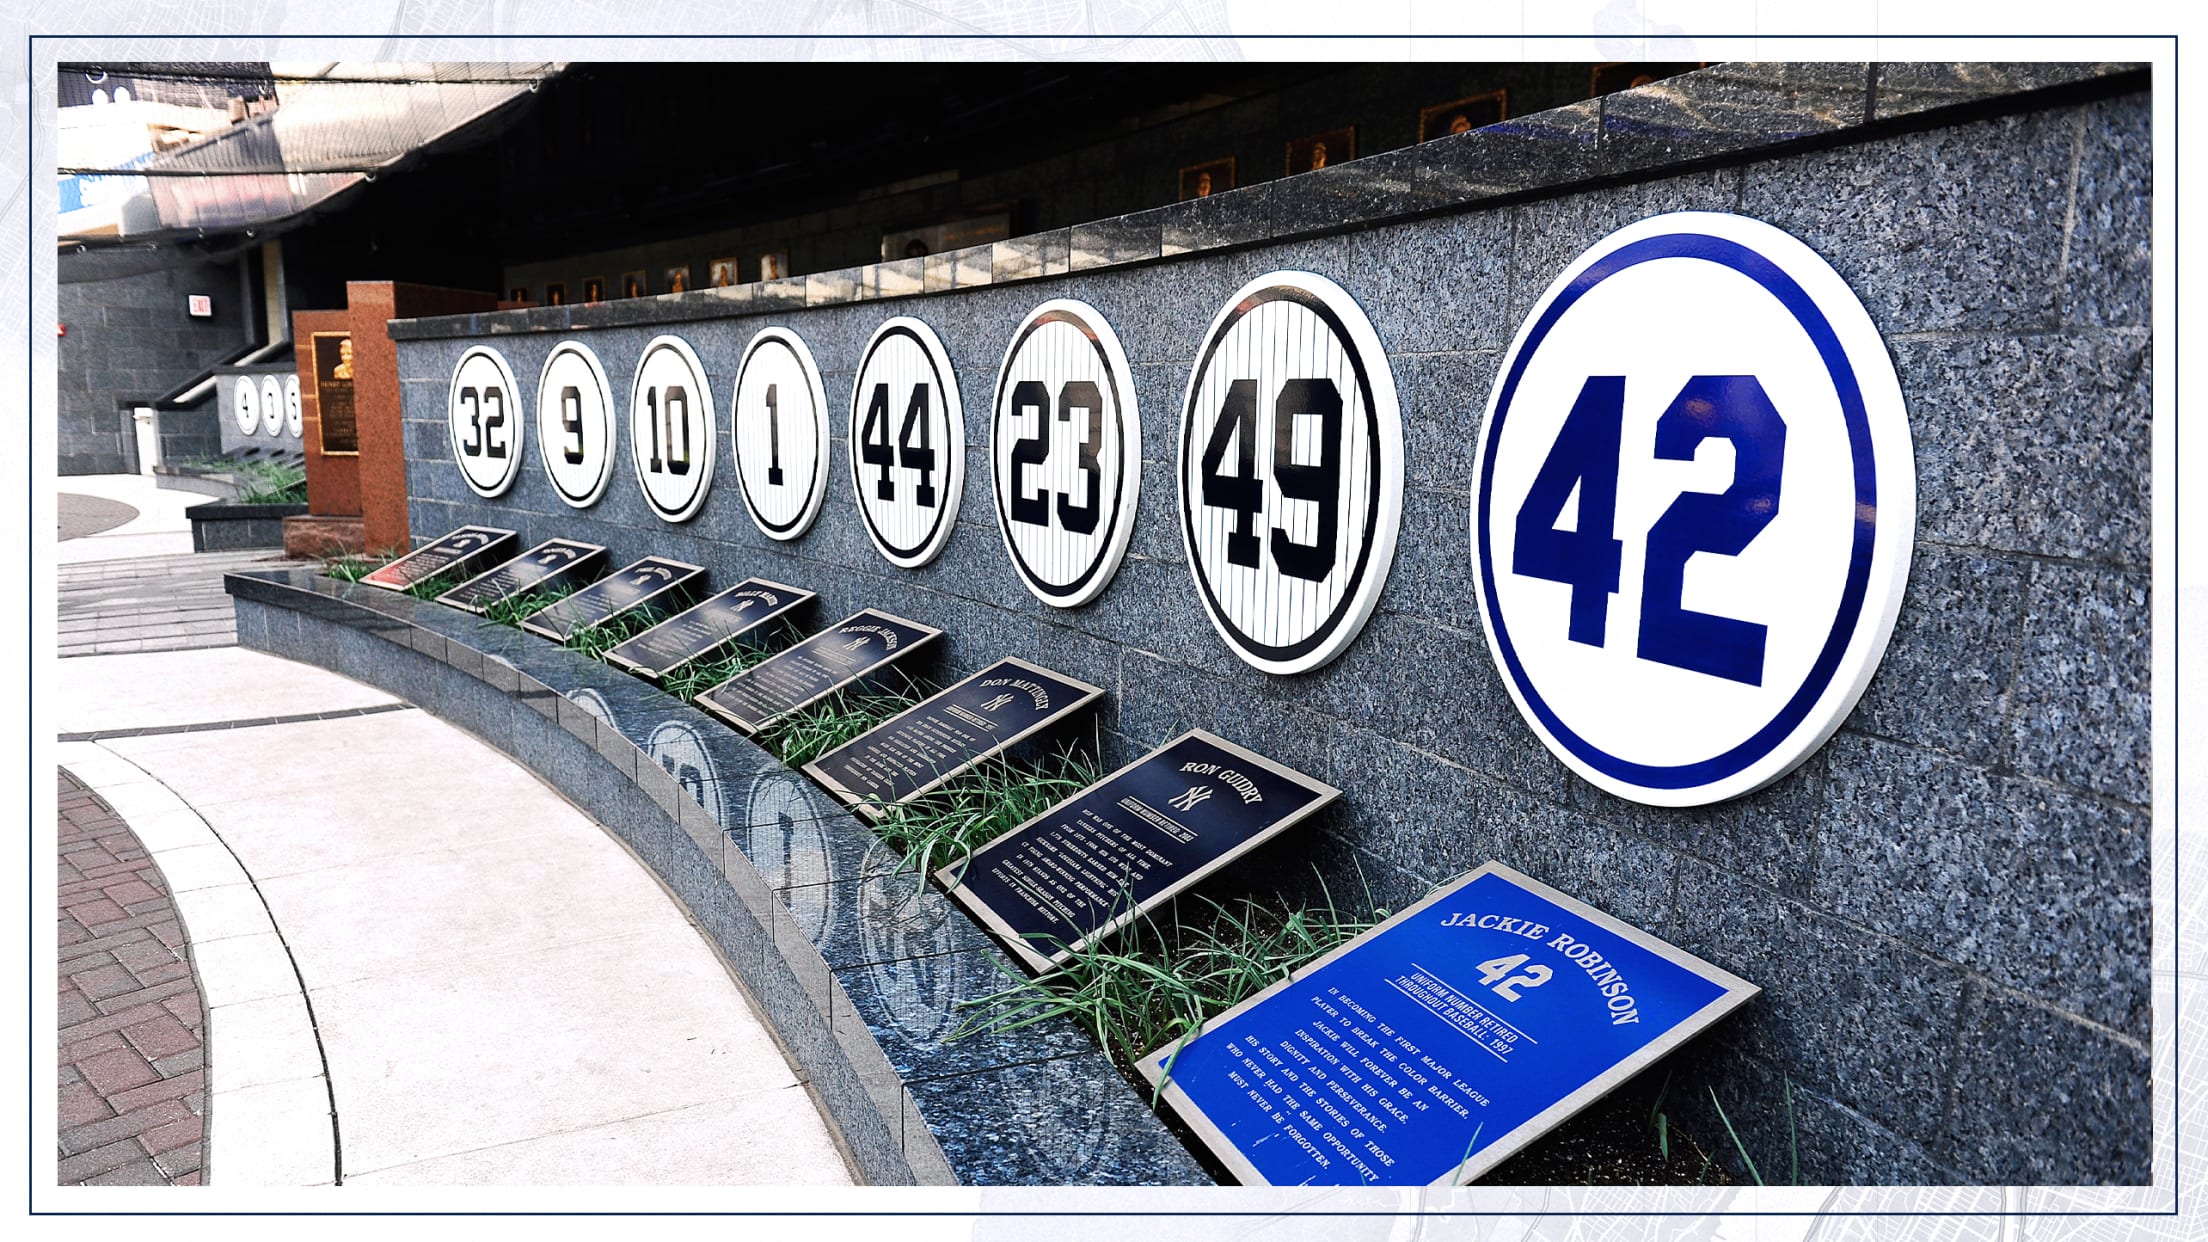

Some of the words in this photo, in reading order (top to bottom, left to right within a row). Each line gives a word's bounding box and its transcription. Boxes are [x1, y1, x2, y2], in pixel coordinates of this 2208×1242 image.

[241, 391, 250, 419] 4
[460, 386, 506, 459] 32
[562, 386, 584, 465] 9
[647, 386, 690, 476] 10
[766, 384, 783, 487] 1
[862, 383, 935, 508] 44
[1011, 381, 1102, 535] 23
[1202, 378, 1343, 583] 49
[1513, 375, 1787, 687] 42
[979, 678, 1013, 687] DON
[1009, 679, 1049, 711] MATTINGLY
[1167, 785, 1213, 812] NY
[1179, 762, 1221, 776] RON
[1218, 769, 1263, 805] GUIDRY
[1411, 973, 1449, 998] UNIFORM
[1445, 995, 1483, 1020] NUMBER
[1479, 1017, 1518, 1042] RETIRED
[1441, 913, 1549, 940] JACKIE
[1547, 933, 1640, 1026] ROBINSON
[1475, 953, 1554, 1003] 42
[1312, 997, 1338, 1017] PLAYER
[1340, 1017, 1351, 1026] TO
[1351, 1027, 1379, 1048] BREAK
[1380, 1048, 1397, 1062] THE
[1399, 1063, 1427, 1085] COLOR
[1328, 987, 1339, 995] IN
[1338, 995, 1376, 1022] BECOMING
[1378, 1023, 1395, 1036] THE
[1395, 1037, 1420, 1054] FIRST
[1421, 1056, 1451, 1079] MAJOR
[1453, 1080, 1489, 1106] LEAGUE
[1396, 976, 1448, 1010] THROUGHOUT
[1443, 1008, 1488, 1040] BASEBALL:
[1490, 1039, 1513, 1054] 1997
[1246, 1036, 1259, 1046] HIS
[1259, 1048, 1283, 1066] STORY
[1281, 1068, 1298, 1081] AND
[1299, 1083, 1316, 1097] THE
[1316, 1098, 1349, 1127] STORIES
[1351, 1129, 1364, 1138] OF
[1365, 1141, 1394, 1166] THOSE
[1280, 1041, 1310, 1064] DIGNITY
[1308, 1067, 1326, 1079] AND
[1327, 1081, 1386, 1133] PERSEVERANCE.
[1295, 1029, 1340, 1064] INSPIRATION
[1340, 1065, 1362, 1083] WITH
[1361, 1084, 1378, 1096] HIS
[1313, 1021, 1340, 1041] JACKIE
[1341, 1041, 1359, 1057] WILL
[1360, 1058, 1397, 1087] FOREVER
[1398, 1088, 1413, 1098] BE
[1413, 1101, 1428, 1111] AN
[1227, 1043, 1243, 1057] WHO
[1242, 1058, 1266, 1078] NEVER
[1264, 1079, 1282, 1093] HAD
[1283, 1095, 1300, 1109] THE
[1300, 1111, 1322, 1130] SAME
[1323, 1133, 1379, 1181] OPPORTUNITY
[1229, 1071, 1248, 1088] MUST
[1248, 1090, 1272, 1112] NEVER
[1272, 1113, 1284, 1123] BE
[1284, 1125, 1330, 1169] FORGOTTEN.
